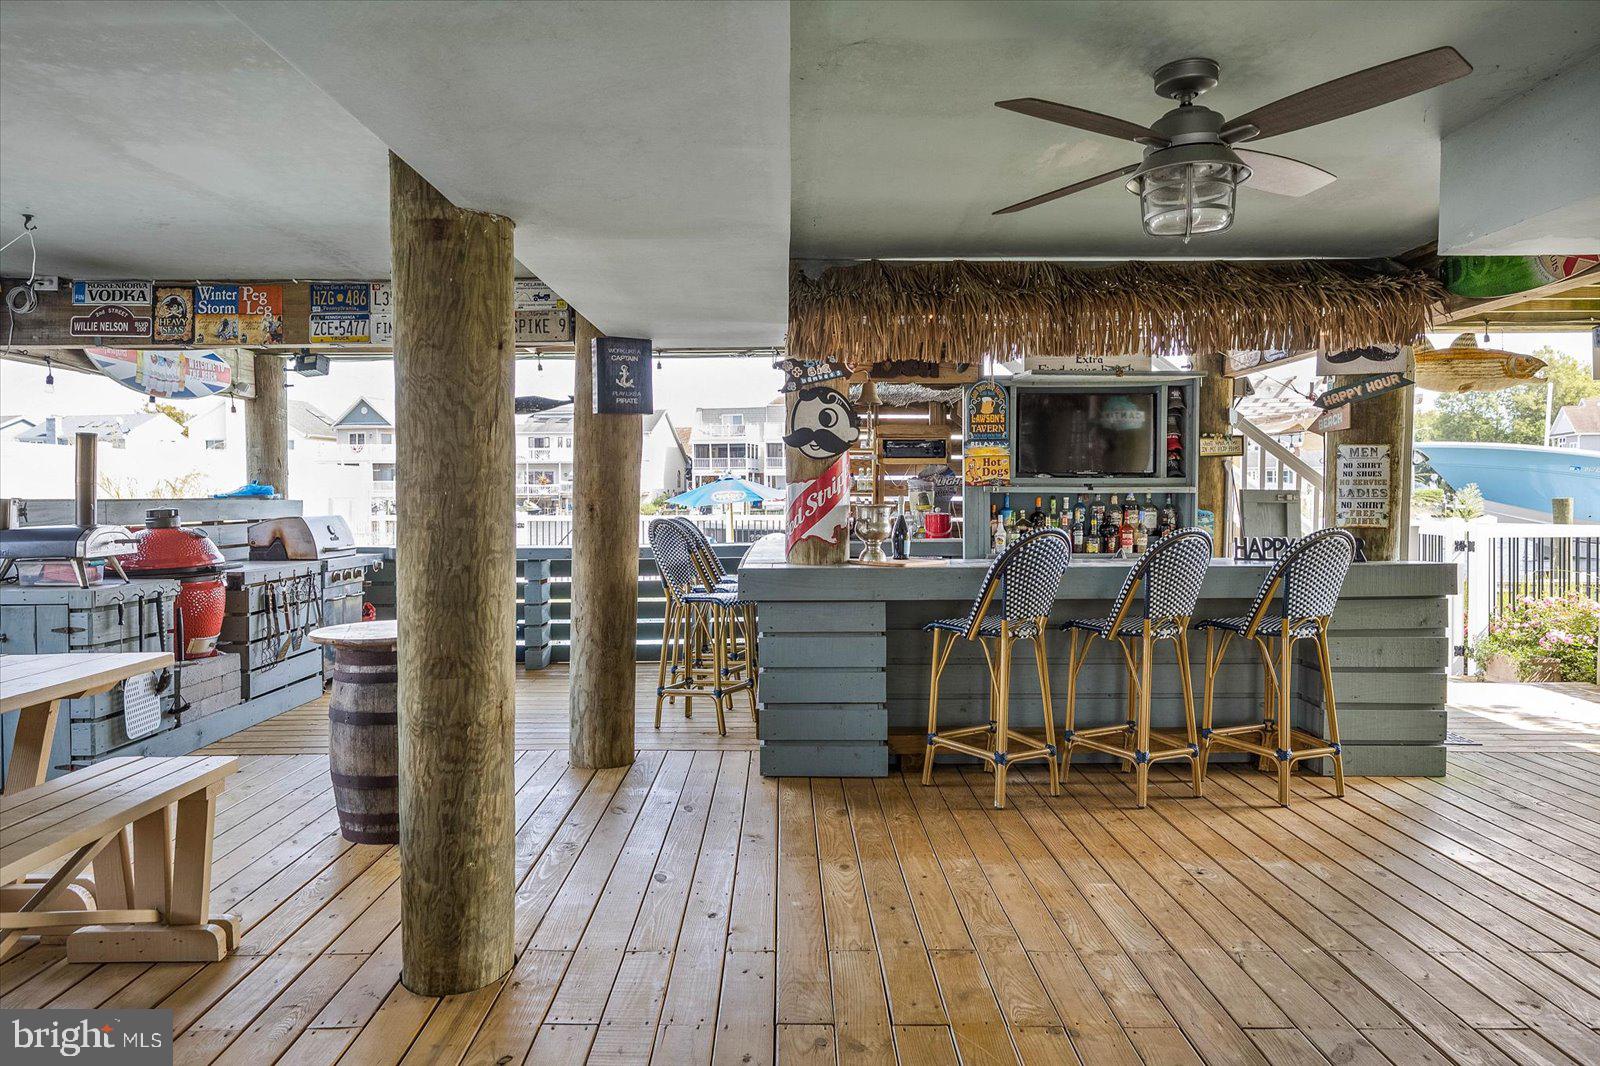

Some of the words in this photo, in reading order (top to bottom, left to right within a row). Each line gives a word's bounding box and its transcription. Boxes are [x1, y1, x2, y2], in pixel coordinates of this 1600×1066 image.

[88, 289, 148, 302] VODKA
[198, 285, 237, 300] Winter
[240, 286, 267, 305] Peg
[313, 290, 335, 305] HZG
[345, 290, 367, 305] 486
[374, 291, 392, 306] L3
[108, 308, 128, 318] STREET
[198, 301, 236, 314] Storm
[246, 301, 272, 319] Leg
[74, 322, 98, 332] WILLIE
[99, 322, 129, 332] NELSON
[160, 318, 187, 326] HEAVY
[558, 318, 566, 333] 9
[1076, 355, 1103, 364] Extra
[1323, 385, 1362, 406] HAPPY
[1365, 374, 1400, 393] HOUR
[971, 424, 1005, 432] TAVERN
[1349, 447, 1378, 457] MEN
[983, 458, 1001, 466] Hot
[982, 468, 1009, 477] Dogs
[1338, 488, 1388, 498] LADIES
